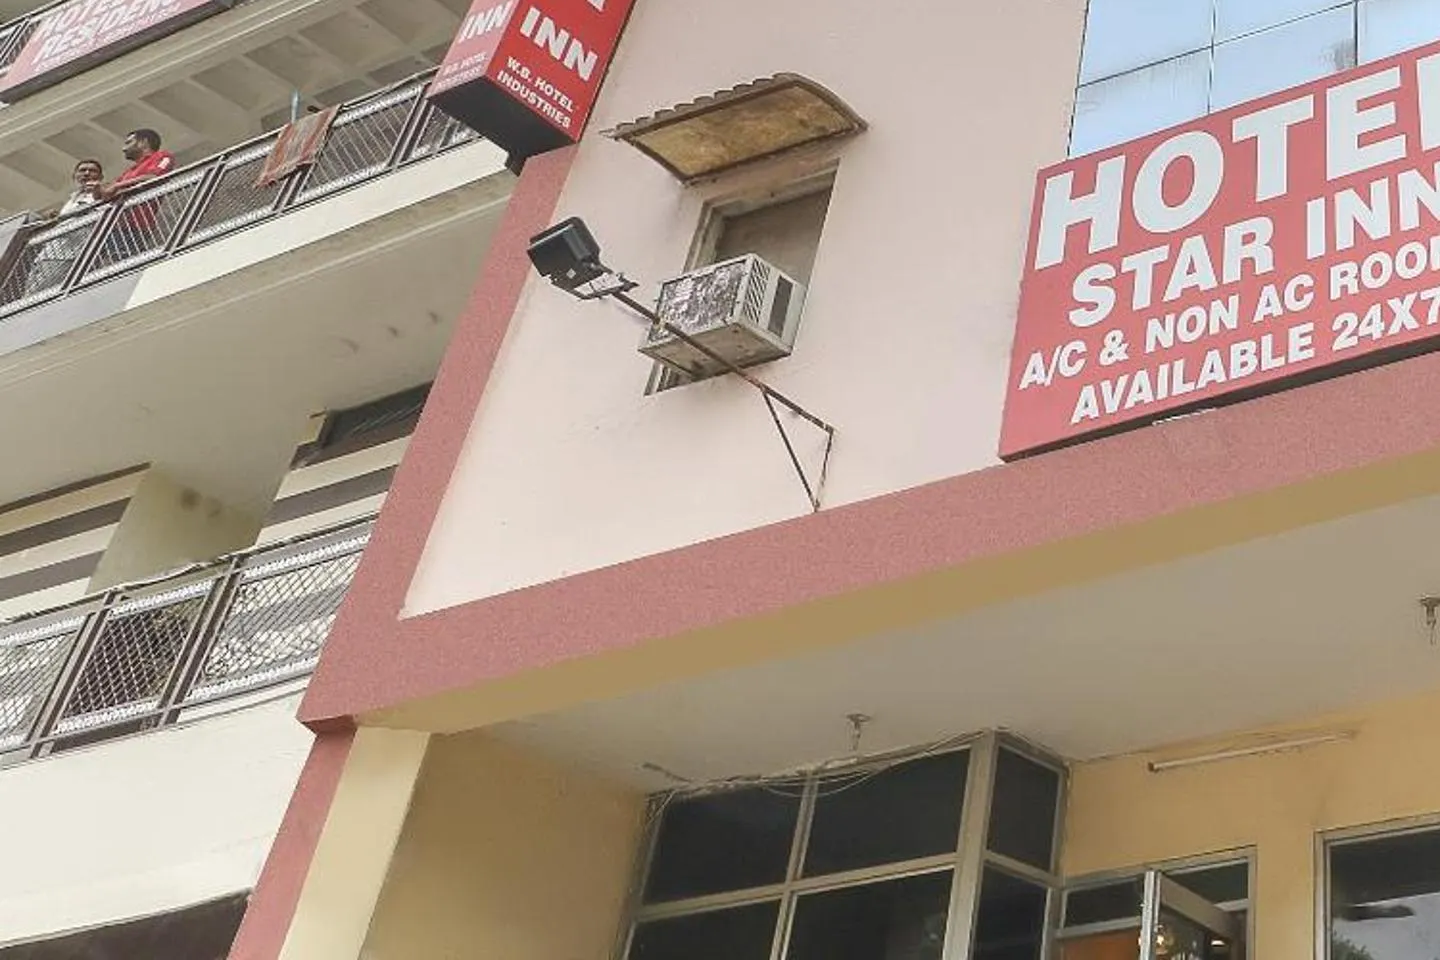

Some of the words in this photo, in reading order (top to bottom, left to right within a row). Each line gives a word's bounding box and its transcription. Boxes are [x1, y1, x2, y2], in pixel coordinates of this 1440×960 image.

[458, 0, 513, 43] INN
[520, 6, 598, 82] INN
[497, 70, 572, 129] INDUSTRIES
[507, 56, 532, 83] W.B.
[534, 76, 574, 113] HOTEL
[1068, 216, 1275, 328] STAR
[1018, 341, 1087, 390] A/C
[1099, 329, 1130, 366] &
[1145, 296, 1240, 354] NON
[1252, 274, 1315, 324] AC
[1070, 323, 1316, 425] AVAILABLE
